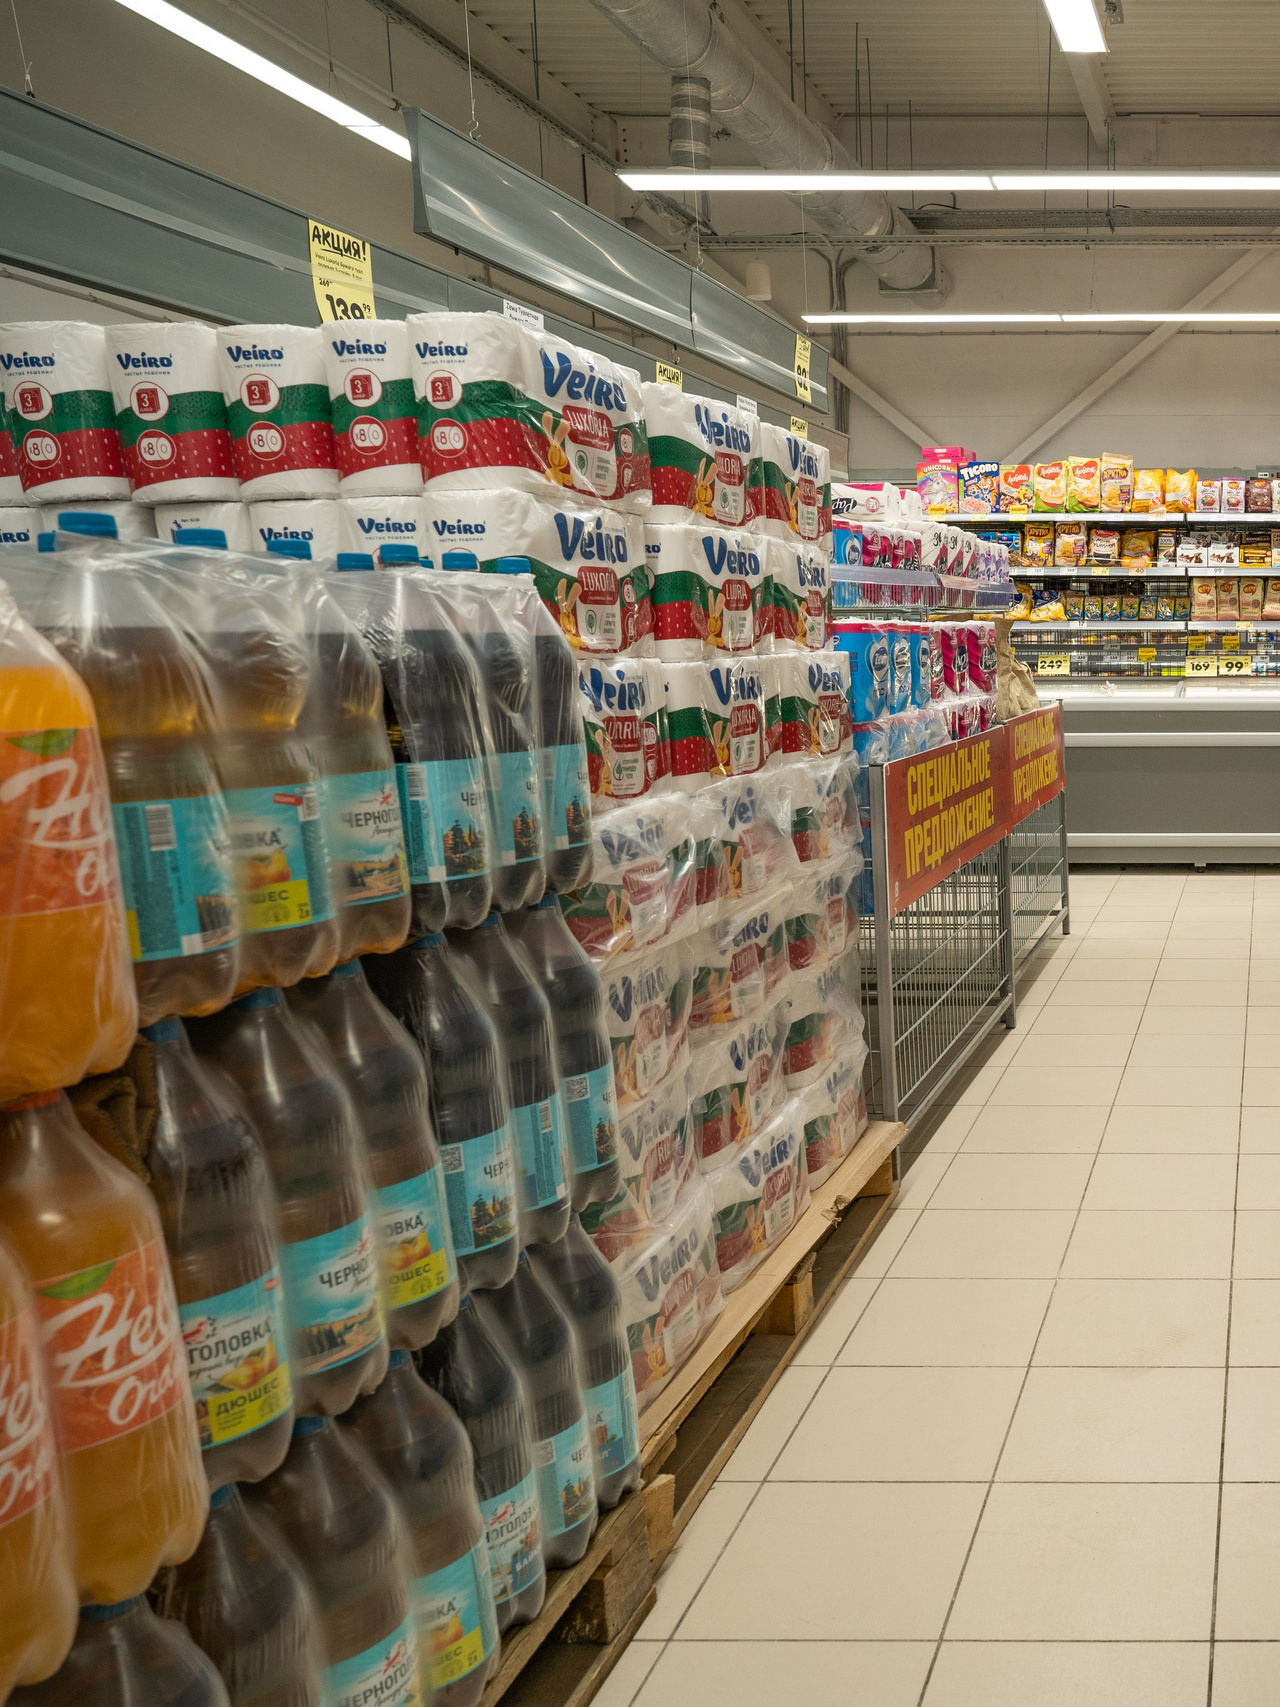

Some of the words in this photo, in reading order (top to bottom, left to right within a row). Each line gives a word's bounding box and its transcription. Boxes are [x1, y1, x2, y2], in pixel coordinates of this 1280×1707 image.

[312, 225, 366, 261] АКЦИЯ!
[326, 294, 365, 321] 139
[363, 303, 371, 312] 99
[540, 348, 627, 412] Veiro
[658, 365, 682, 384] АКЦИЯ!
[567, 410, 609, 439] LUXORIA
[923, 464, 951, 473] UNICORN
[960, 463, 998, 481] TIGORO
[1103, 468, 1129, 480] ХРУТКА
[582, 571, 616, 594] LUXORIA
[1039, 660, 1063, 670] 249
[1191, 660, 1210, 672] 169
[1225, 661, 1244, 673] 99
[1014, 712, 1054, 760] СПЕЦИАЛЬНОЕ
[907, 740, 991, 816] СПЕЦИАЛЬНОЕ
[904, 787, 995, 879] ПРЕДЛОЖЕНИЕ!
[216, 1377, 280, 1418] ДЮШЕС
